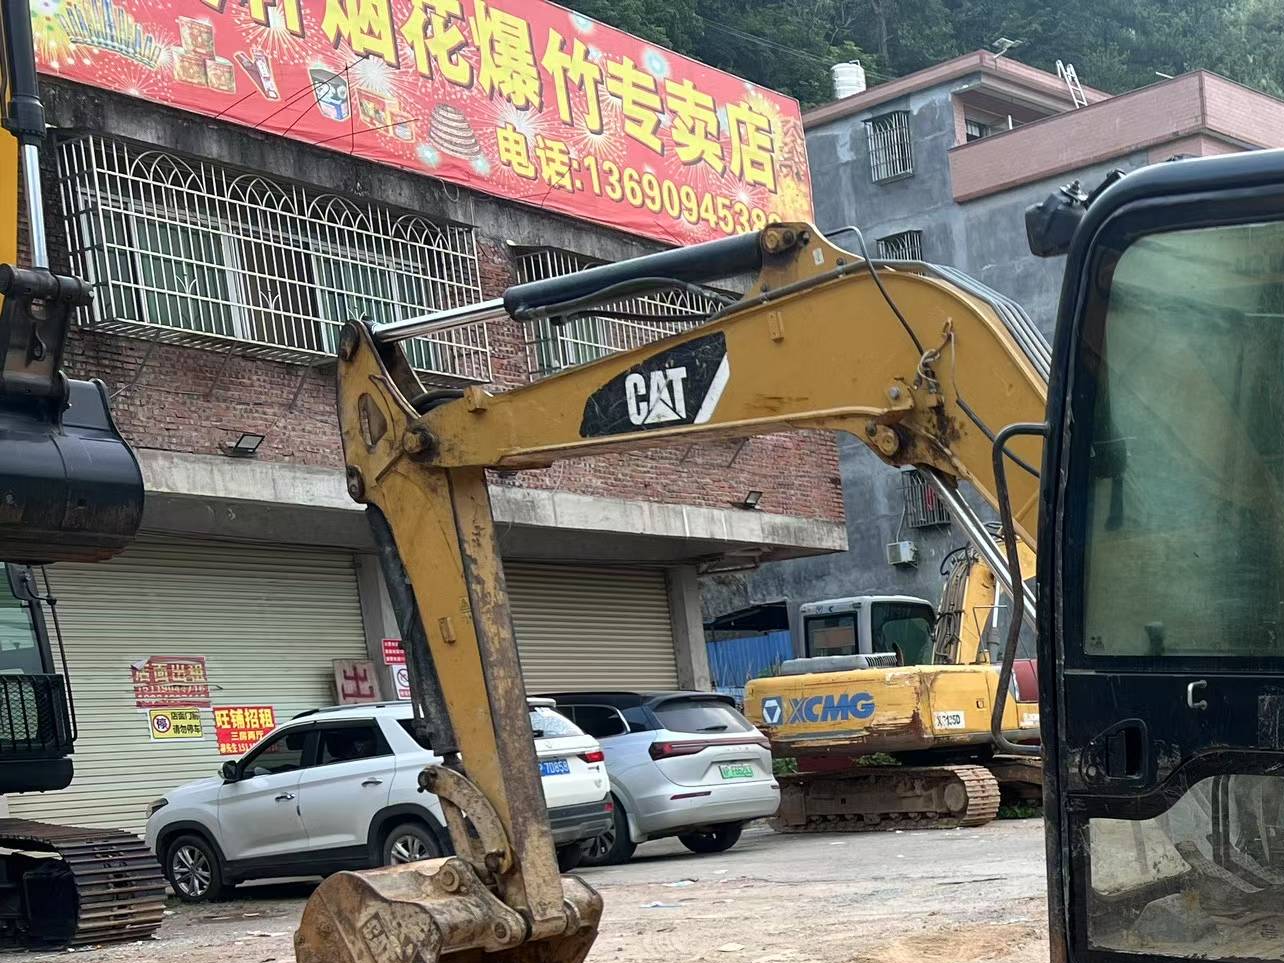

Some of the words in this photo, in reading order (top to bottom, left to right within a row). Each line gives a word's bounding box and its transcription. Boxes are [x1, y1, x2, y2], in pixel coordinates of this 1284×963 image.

[200, 0, 780, 190] 烟花爆竹专卖店
[625, 366, 687, 425] CAT
[341, 665, 375, 700] 出
[215, 709, 274, 729] 旺铺招租
[786, 691, 875, 724] XCMG
